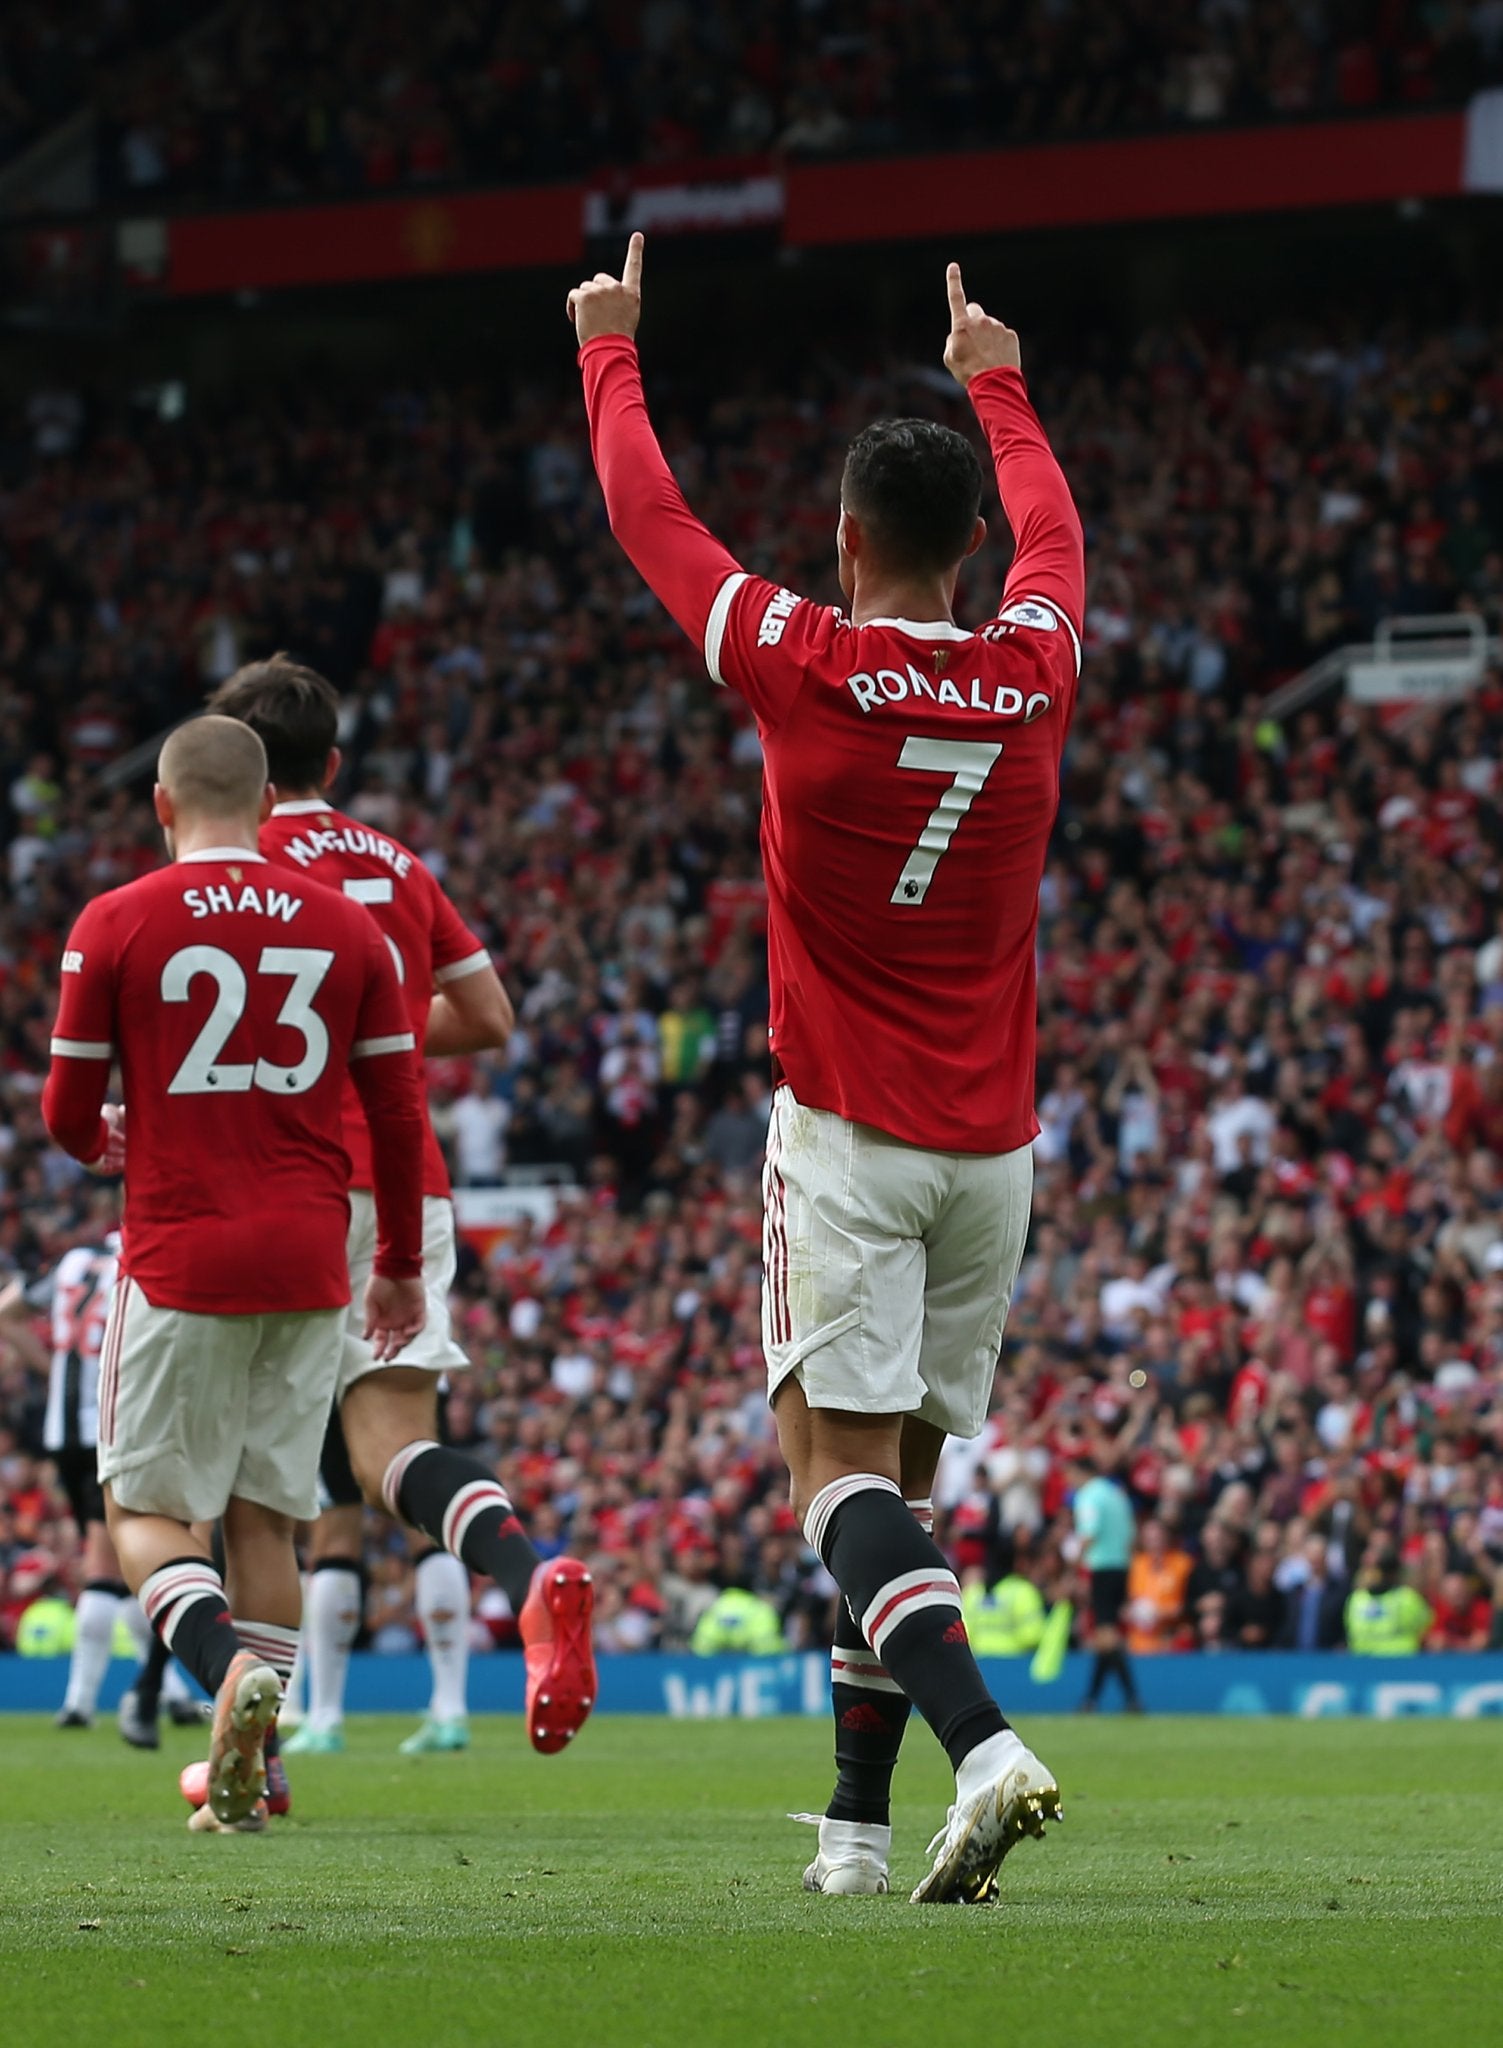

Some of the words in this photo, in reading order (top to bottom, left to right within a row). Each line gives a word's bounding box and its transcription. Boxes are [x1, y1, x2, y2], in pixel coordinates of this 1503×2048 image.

[847, 663, 1051, 723] RONALDO
[890, 736, 1003, 905] 7
[283, 827, 413, 880] MAGUIRE
[183, 884, 303, 923] SHAW
[160, 944, 336, 1095] 23
